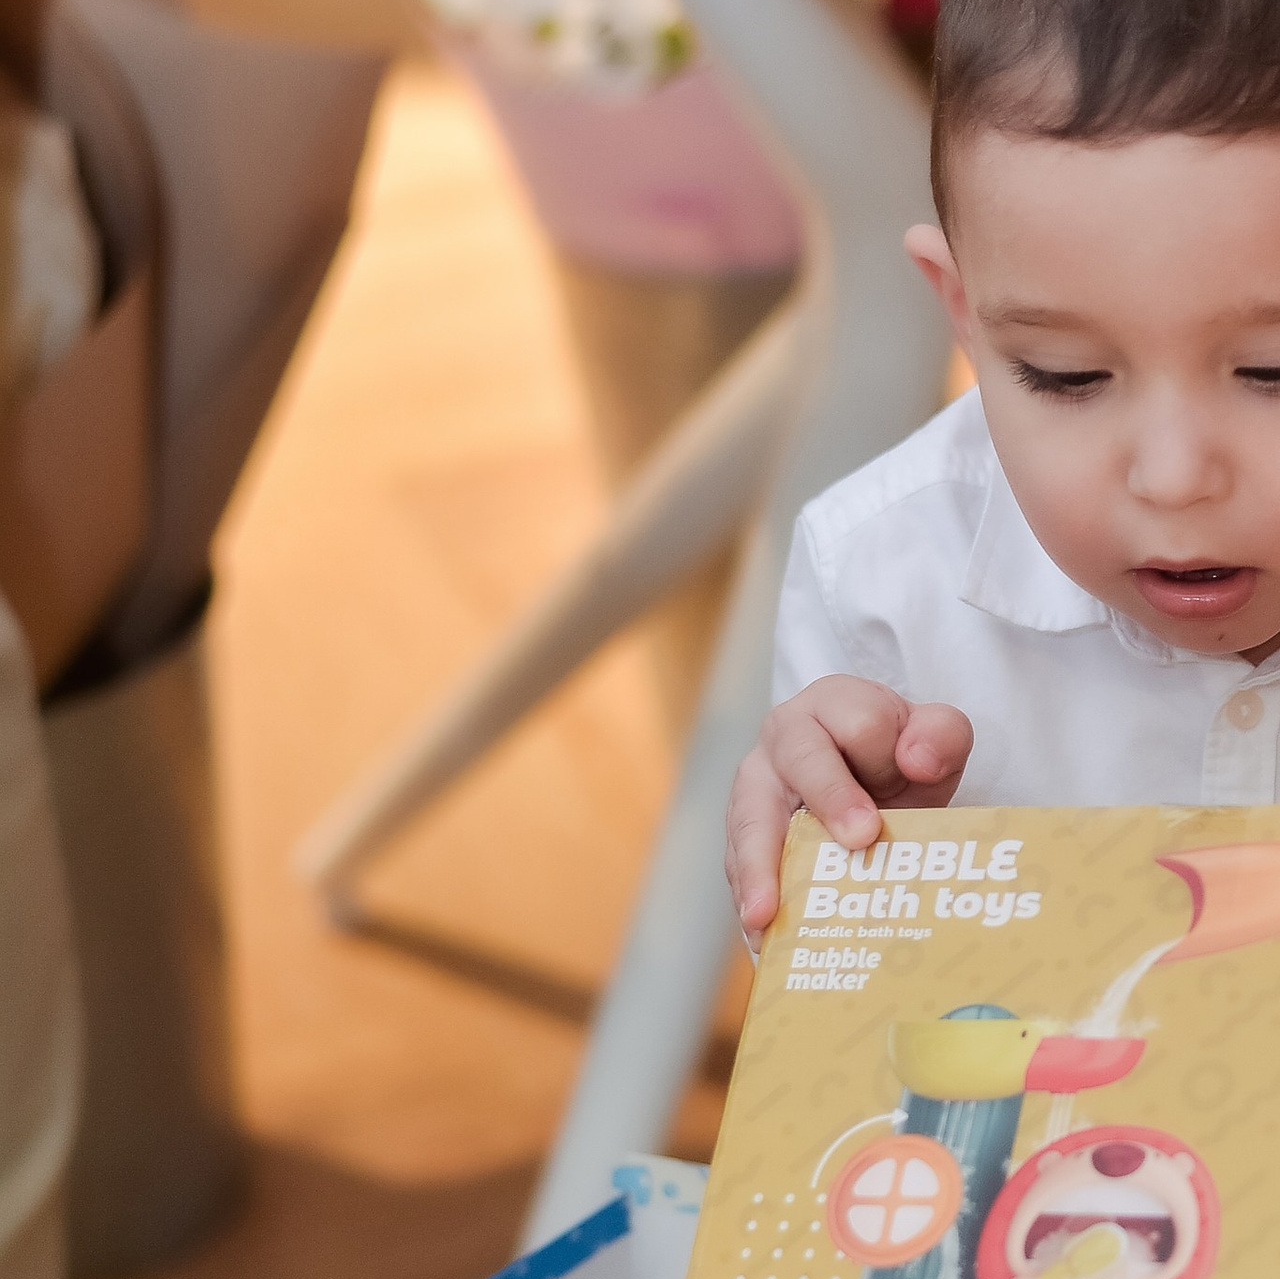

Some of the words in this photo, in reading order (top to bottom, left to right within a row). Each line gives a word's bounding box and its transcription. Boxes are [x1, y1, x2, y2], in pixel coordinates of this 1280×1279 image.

[811, 839, 1024, 882] BUBBLE
[803, 885, 920, 919] Bath
[934, 887, 1043, 927] toys
[797, 925, 854, 938] Paddle
[857, 925, 895, 939] bath
[897, 926, 933, 940] toys
[790, 947, 882, 969] Bubble
[785, 968, 870, 991] maker
